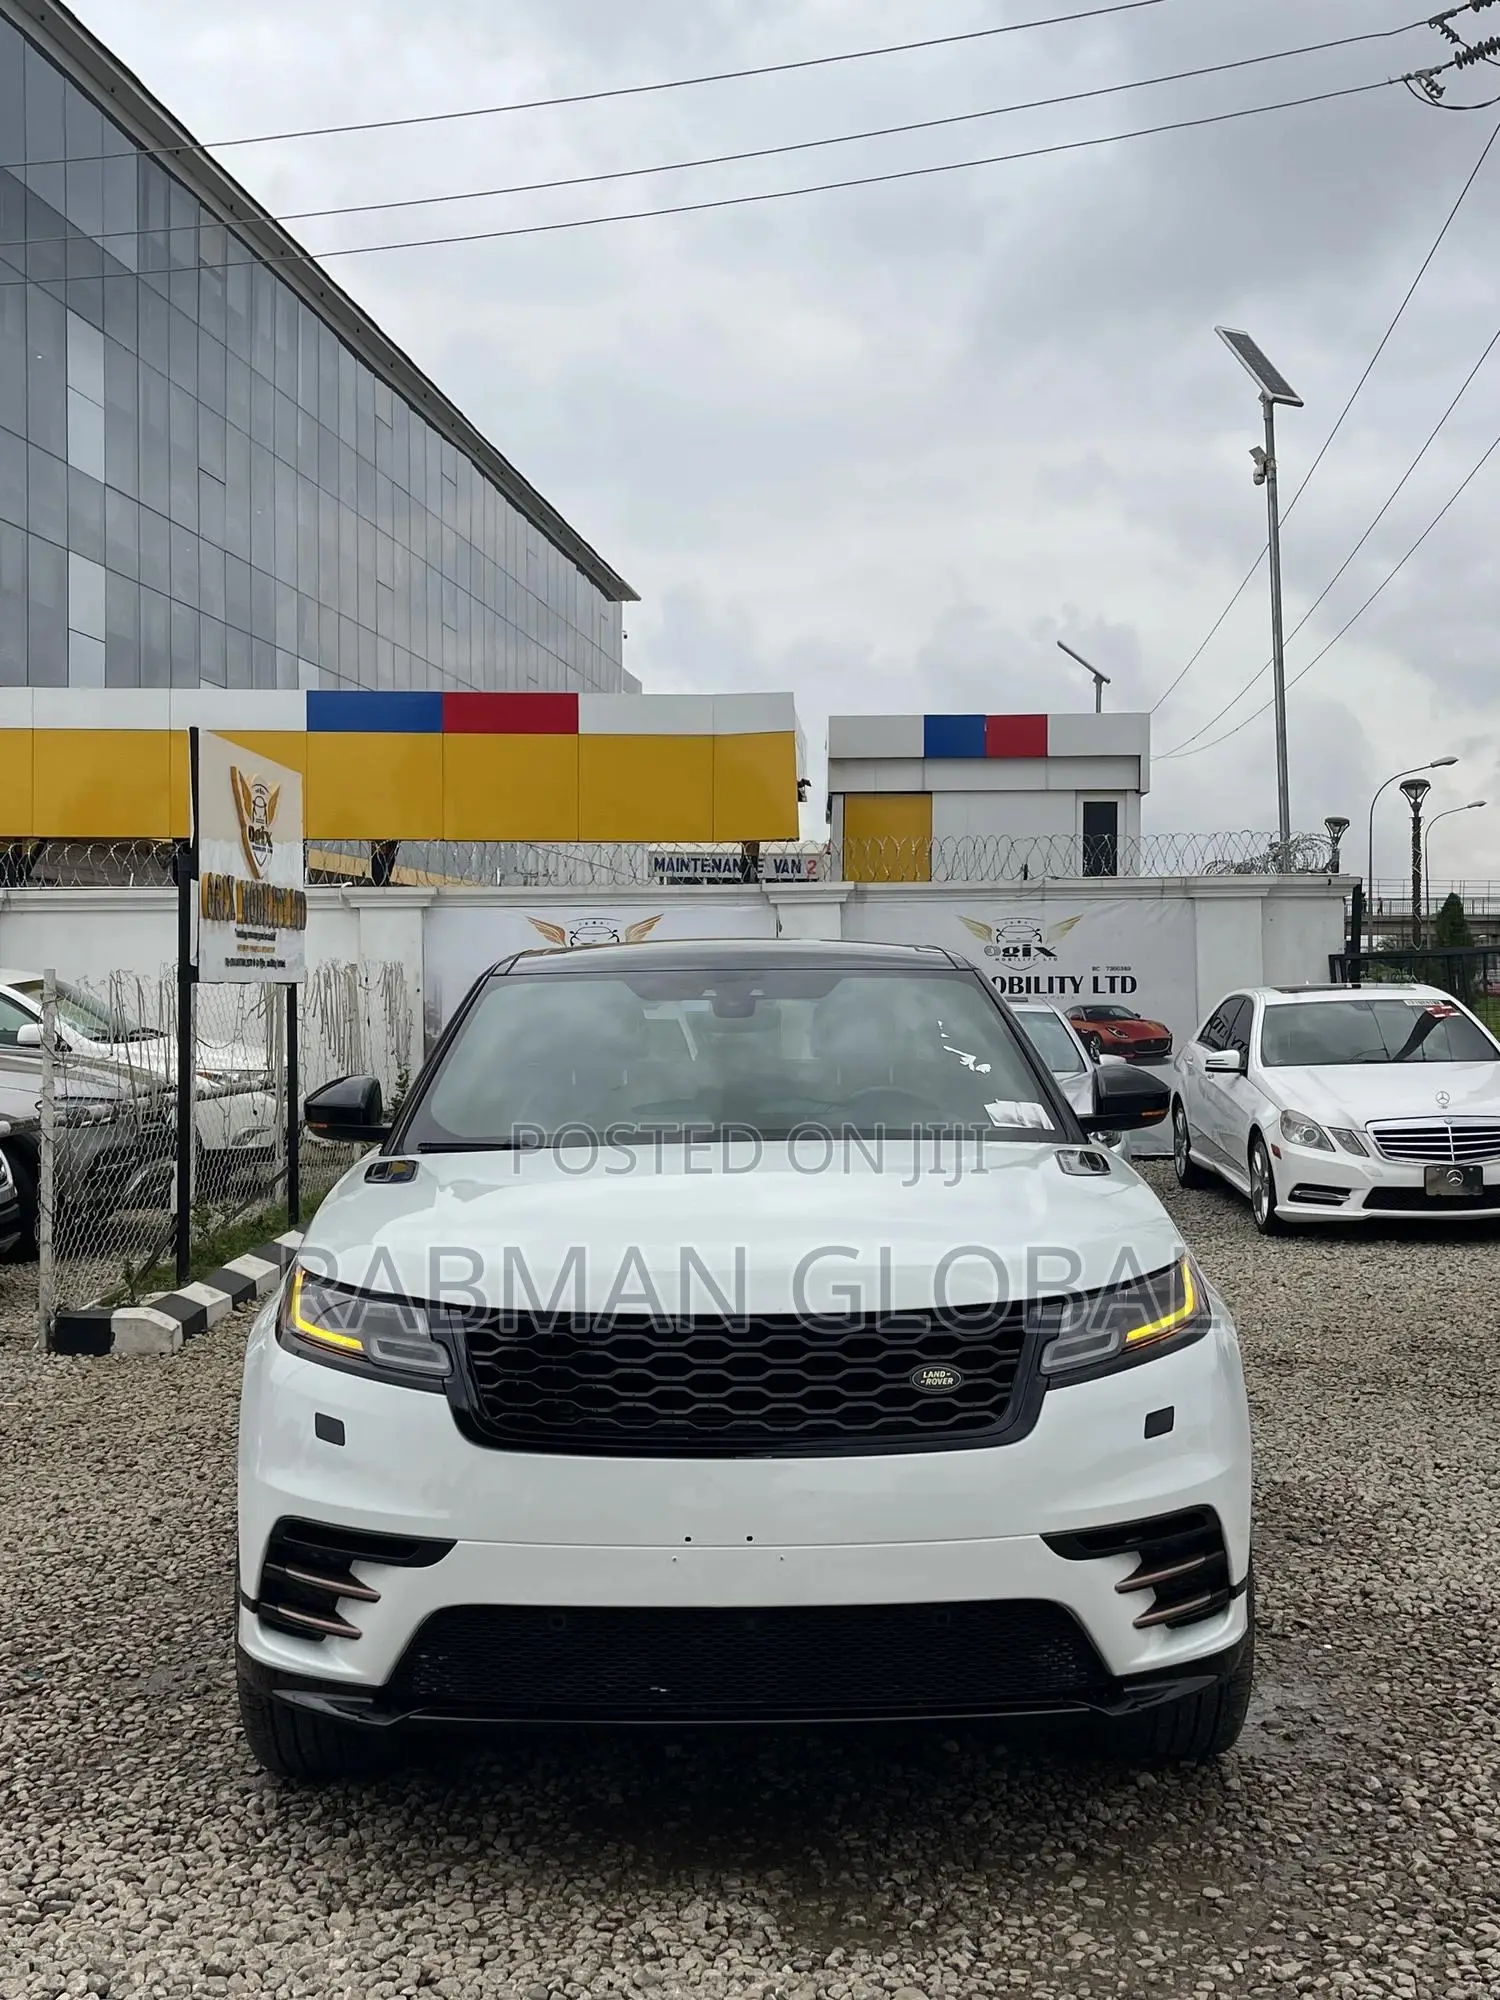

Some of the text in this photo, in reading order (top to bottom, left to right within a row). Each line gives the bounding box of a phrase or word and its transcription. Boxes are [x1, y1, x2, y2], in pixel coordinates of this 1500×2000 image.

[654, 857, 818, 875] MAINTENANE VAN 2
[1092, 975, 1138, 994] LTD
